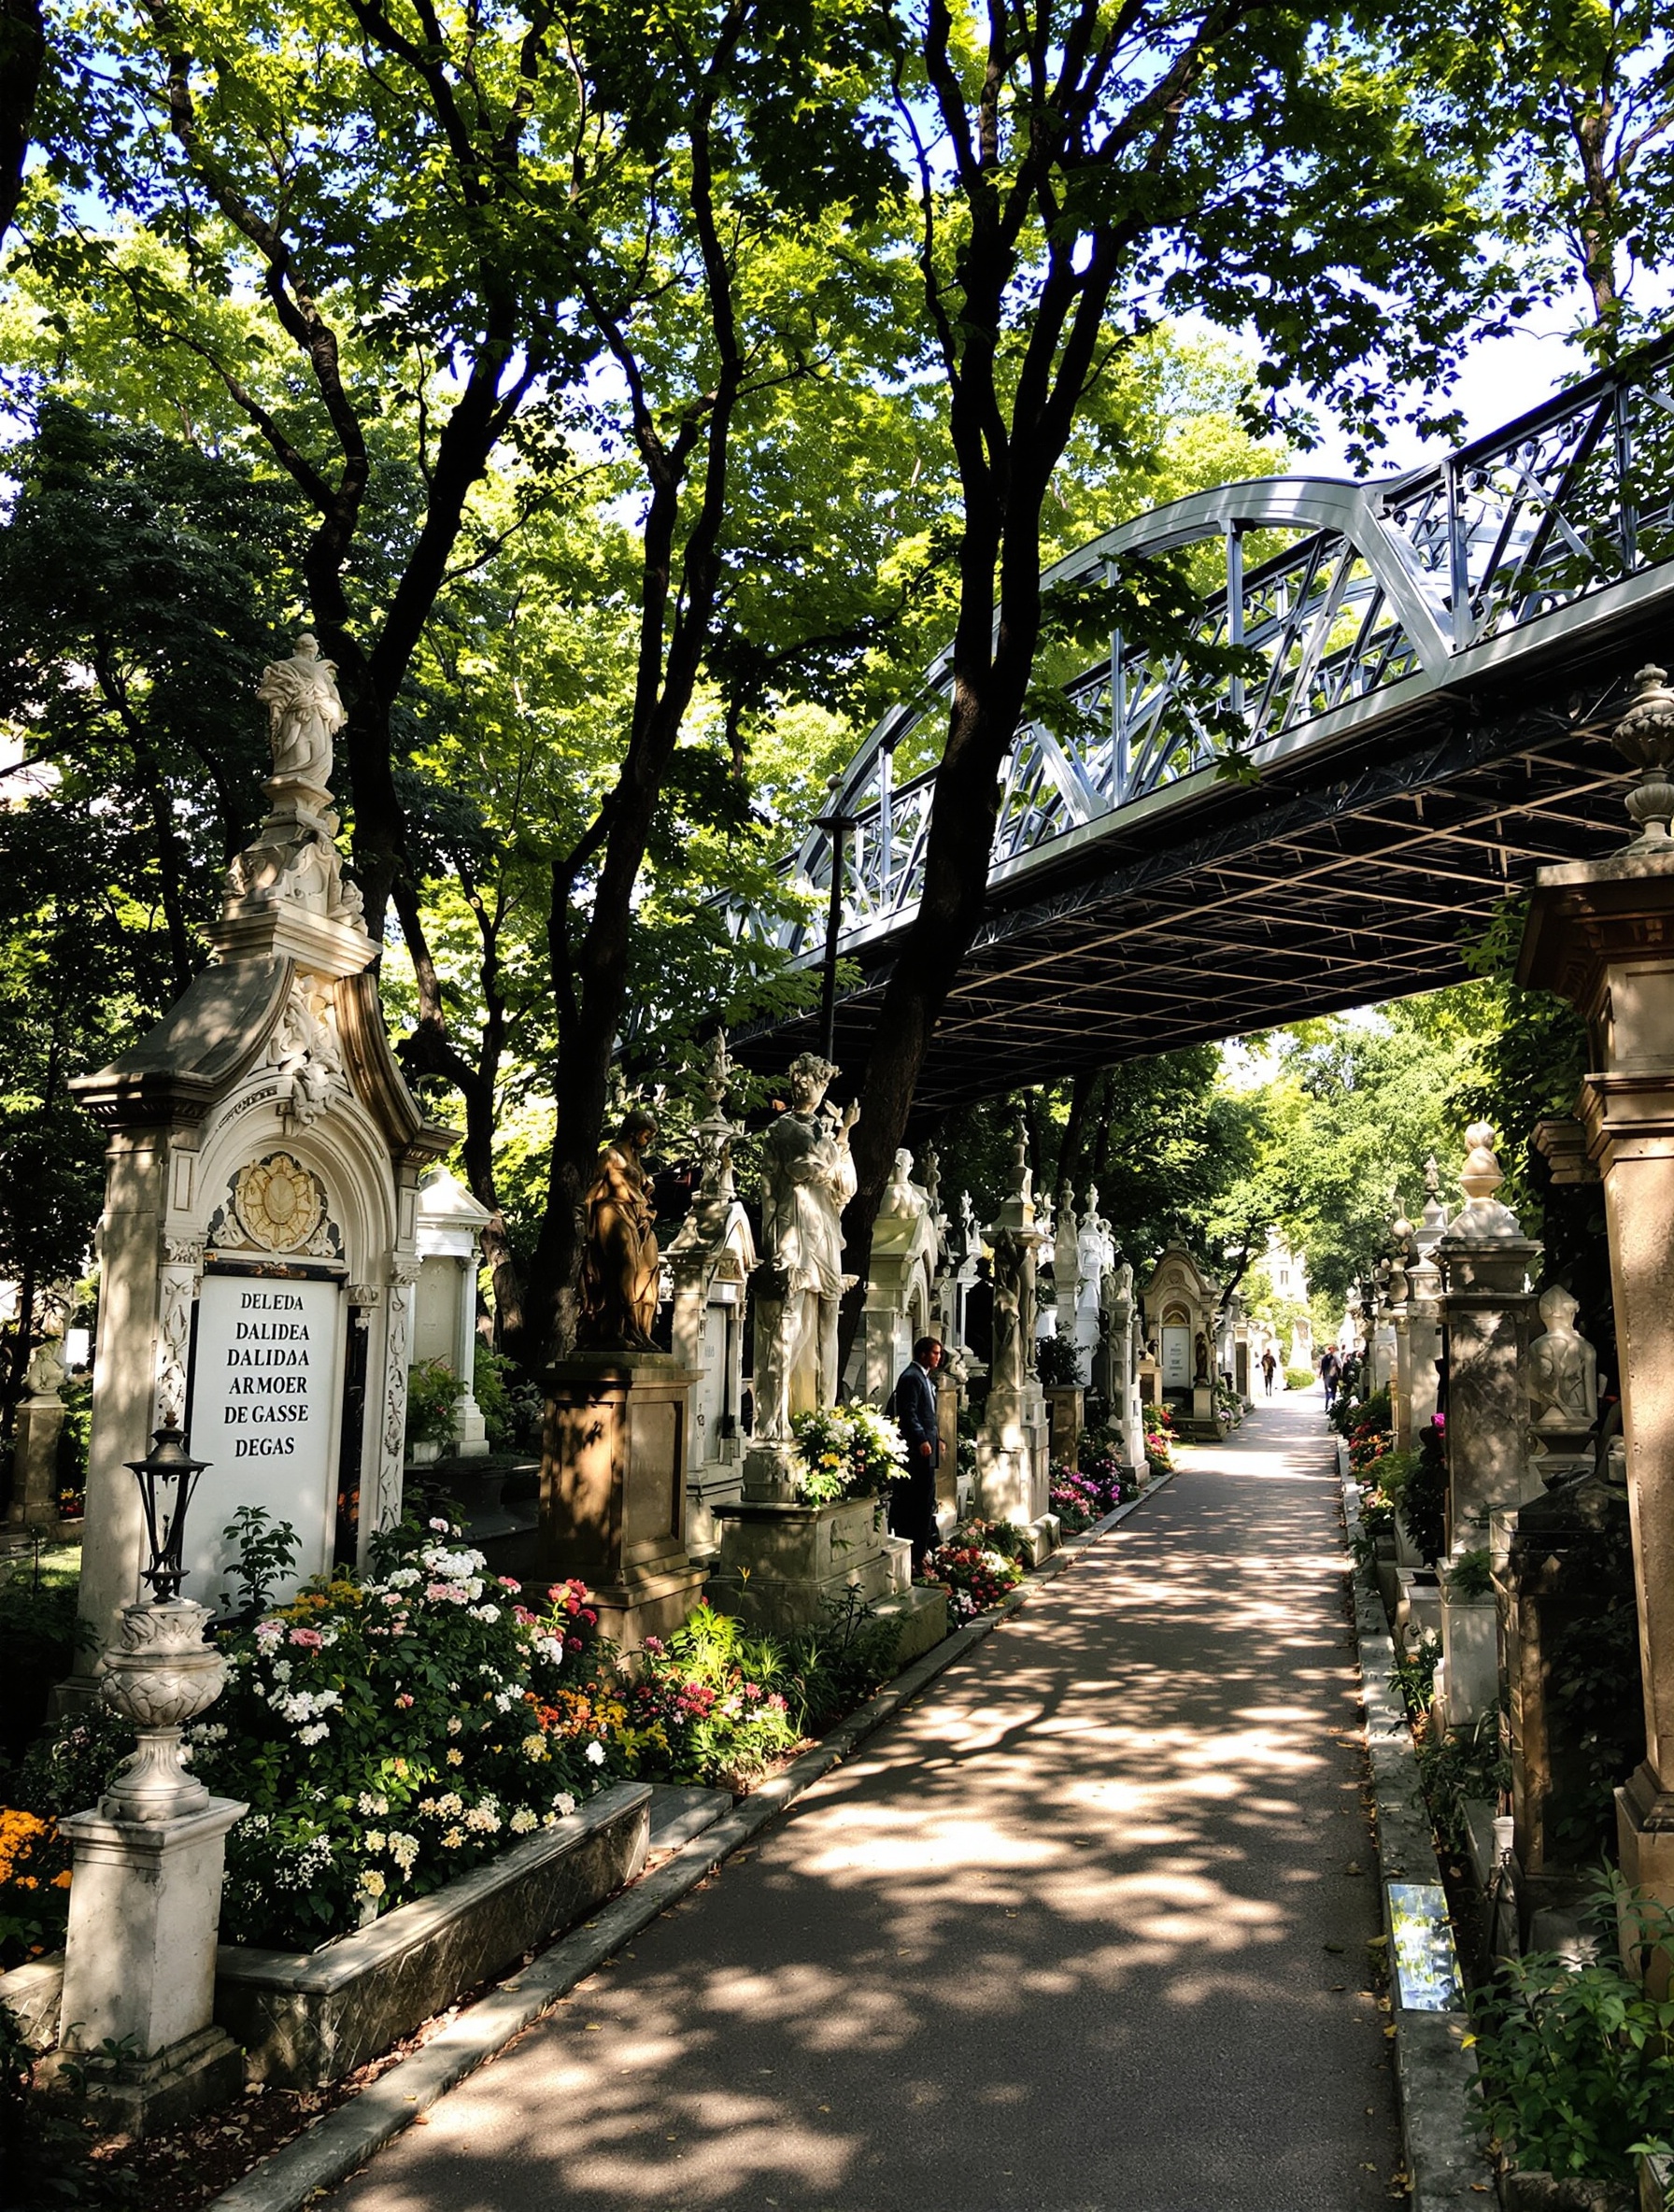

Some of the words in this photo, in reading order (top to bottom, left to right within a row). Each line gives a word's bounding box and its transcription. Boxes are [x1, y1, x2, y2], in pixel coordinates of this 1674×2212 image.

[241, 1292, 304, 1311] DELEDA
[235, 1322, 310, 1340] DALIDEA
[228, 1376, 307, 1395] ARMOER
[223, 1406, 248, 1425] DE
[251, 1404, 309, 1424] GASSE
[234, 1437, 295, 1458] DEGAS
